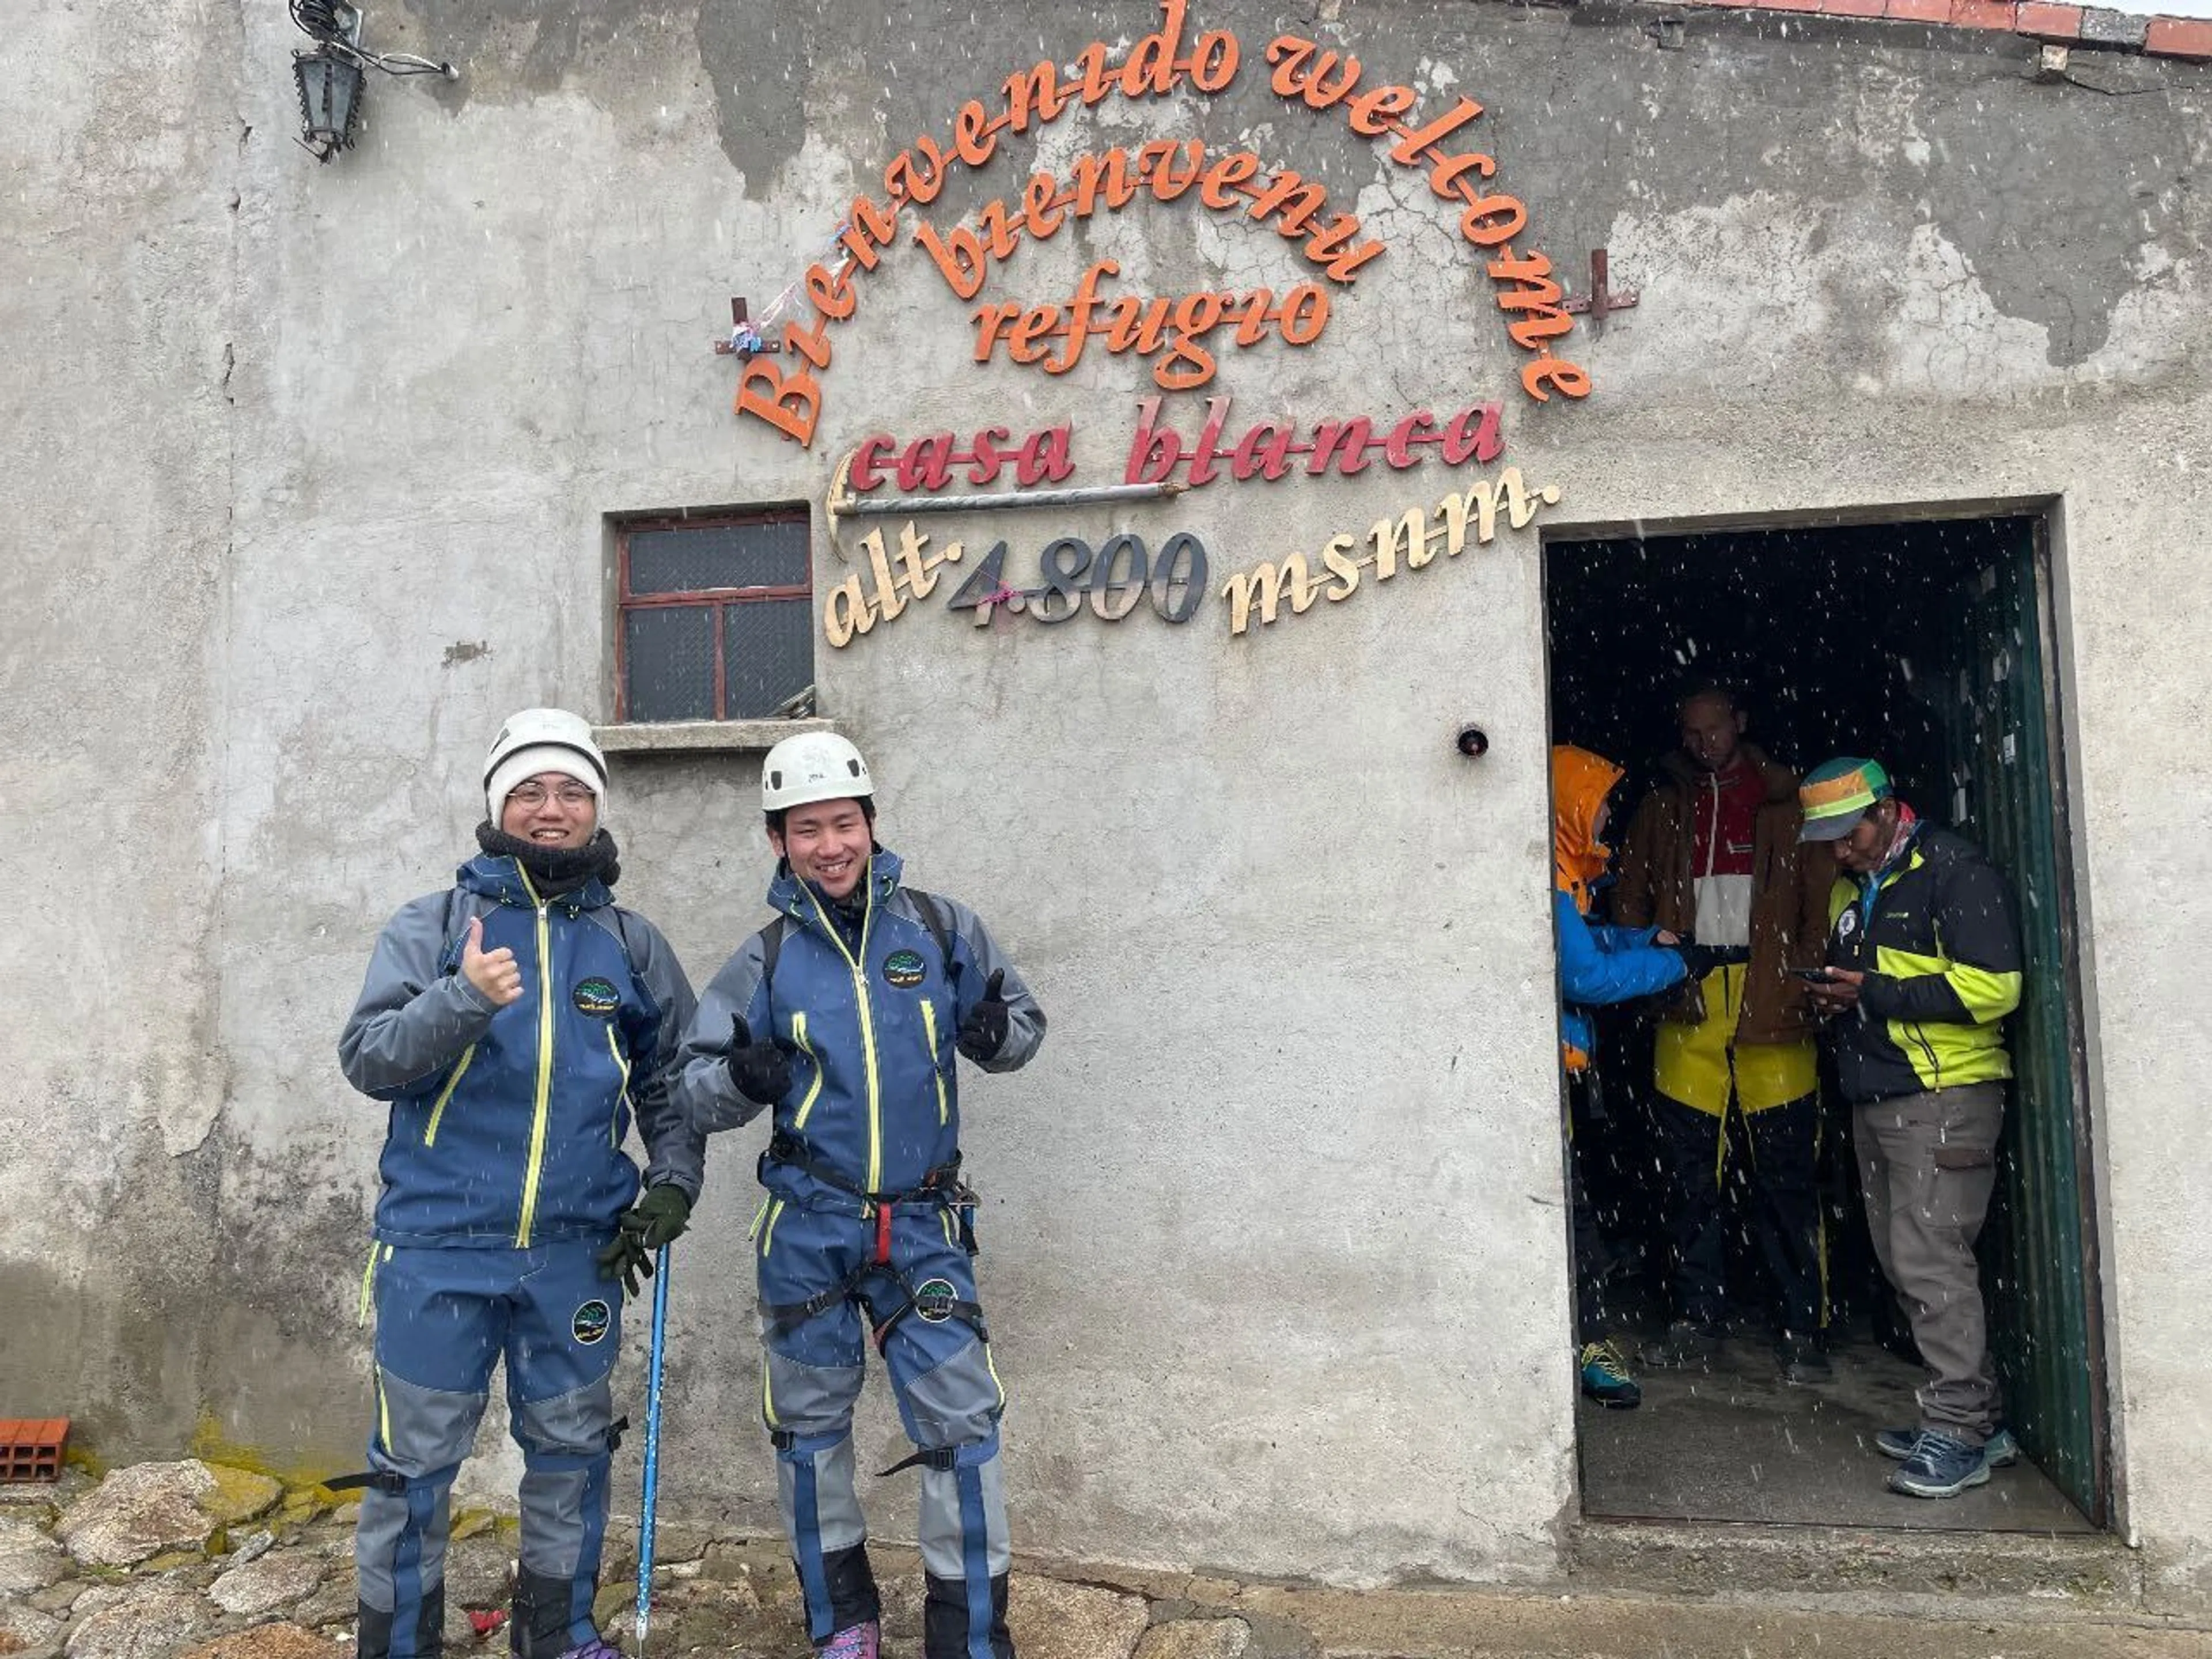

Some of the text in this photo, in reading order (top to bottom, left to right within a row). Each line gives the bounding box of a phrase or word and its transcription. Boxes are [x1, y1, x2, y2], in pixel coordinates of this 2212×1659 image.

[736, 0, 1592, 447] Bienvenido welcome
[914, 140, 1385, 299] bienvenu
[972, 260, 1330, 390] refugio
[851, 396, 1507, 491] casa blanca
[824, 467, 1561, 649] alt. 4.800 msnm.
